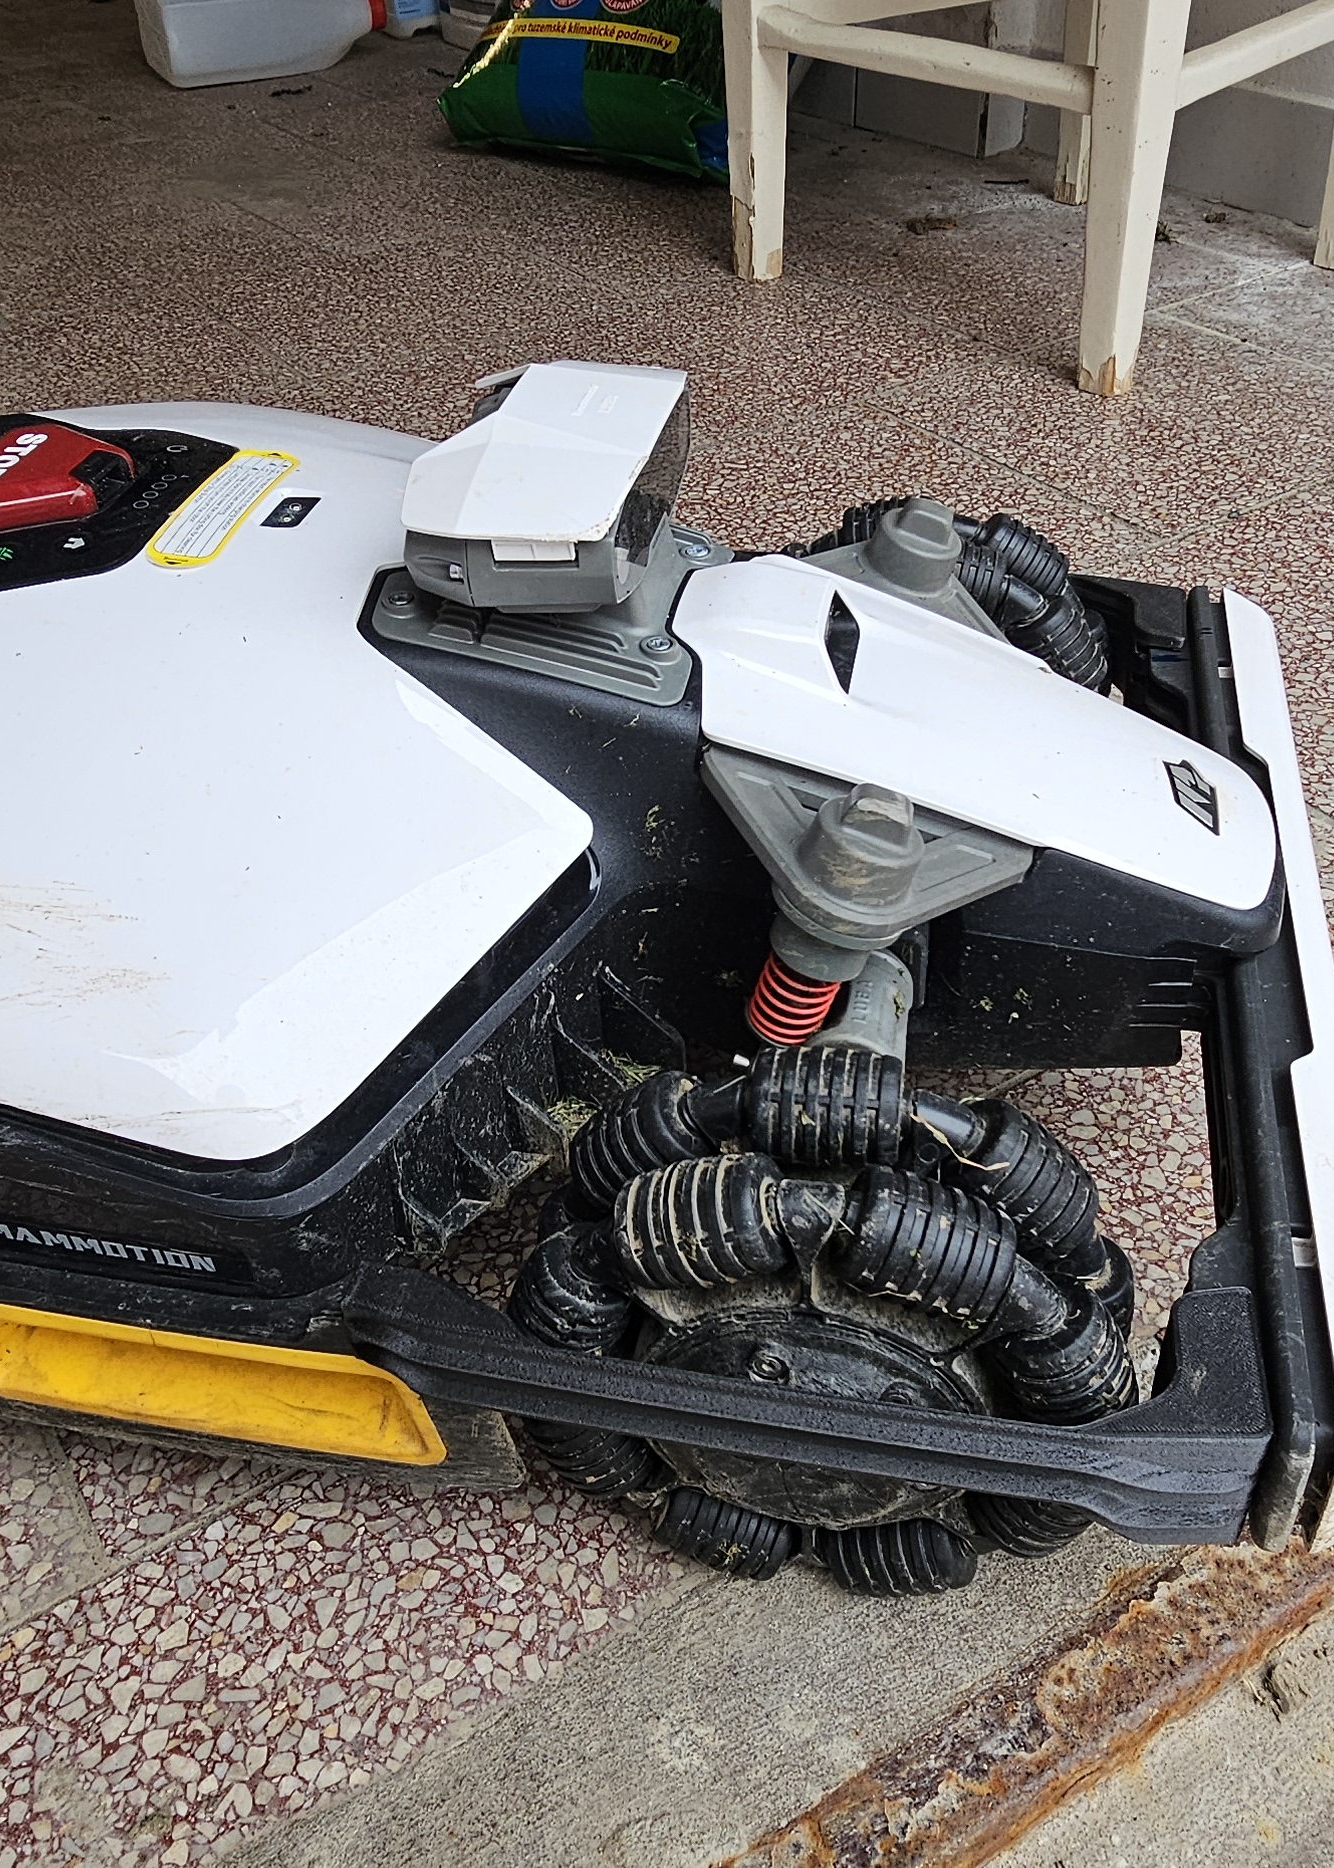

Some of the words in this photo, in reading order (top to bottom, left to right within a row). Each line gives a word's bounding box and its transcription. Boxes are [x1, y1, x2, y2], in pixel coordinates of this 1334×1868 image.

[512, 24, 527, 34] pro
[528, 21, 567, 33] tuzemské
[568, 22, 616, 37] klimatické
[616, 29, 672, 50] podmínky
[851, 981, 874, 1024] LUBA
